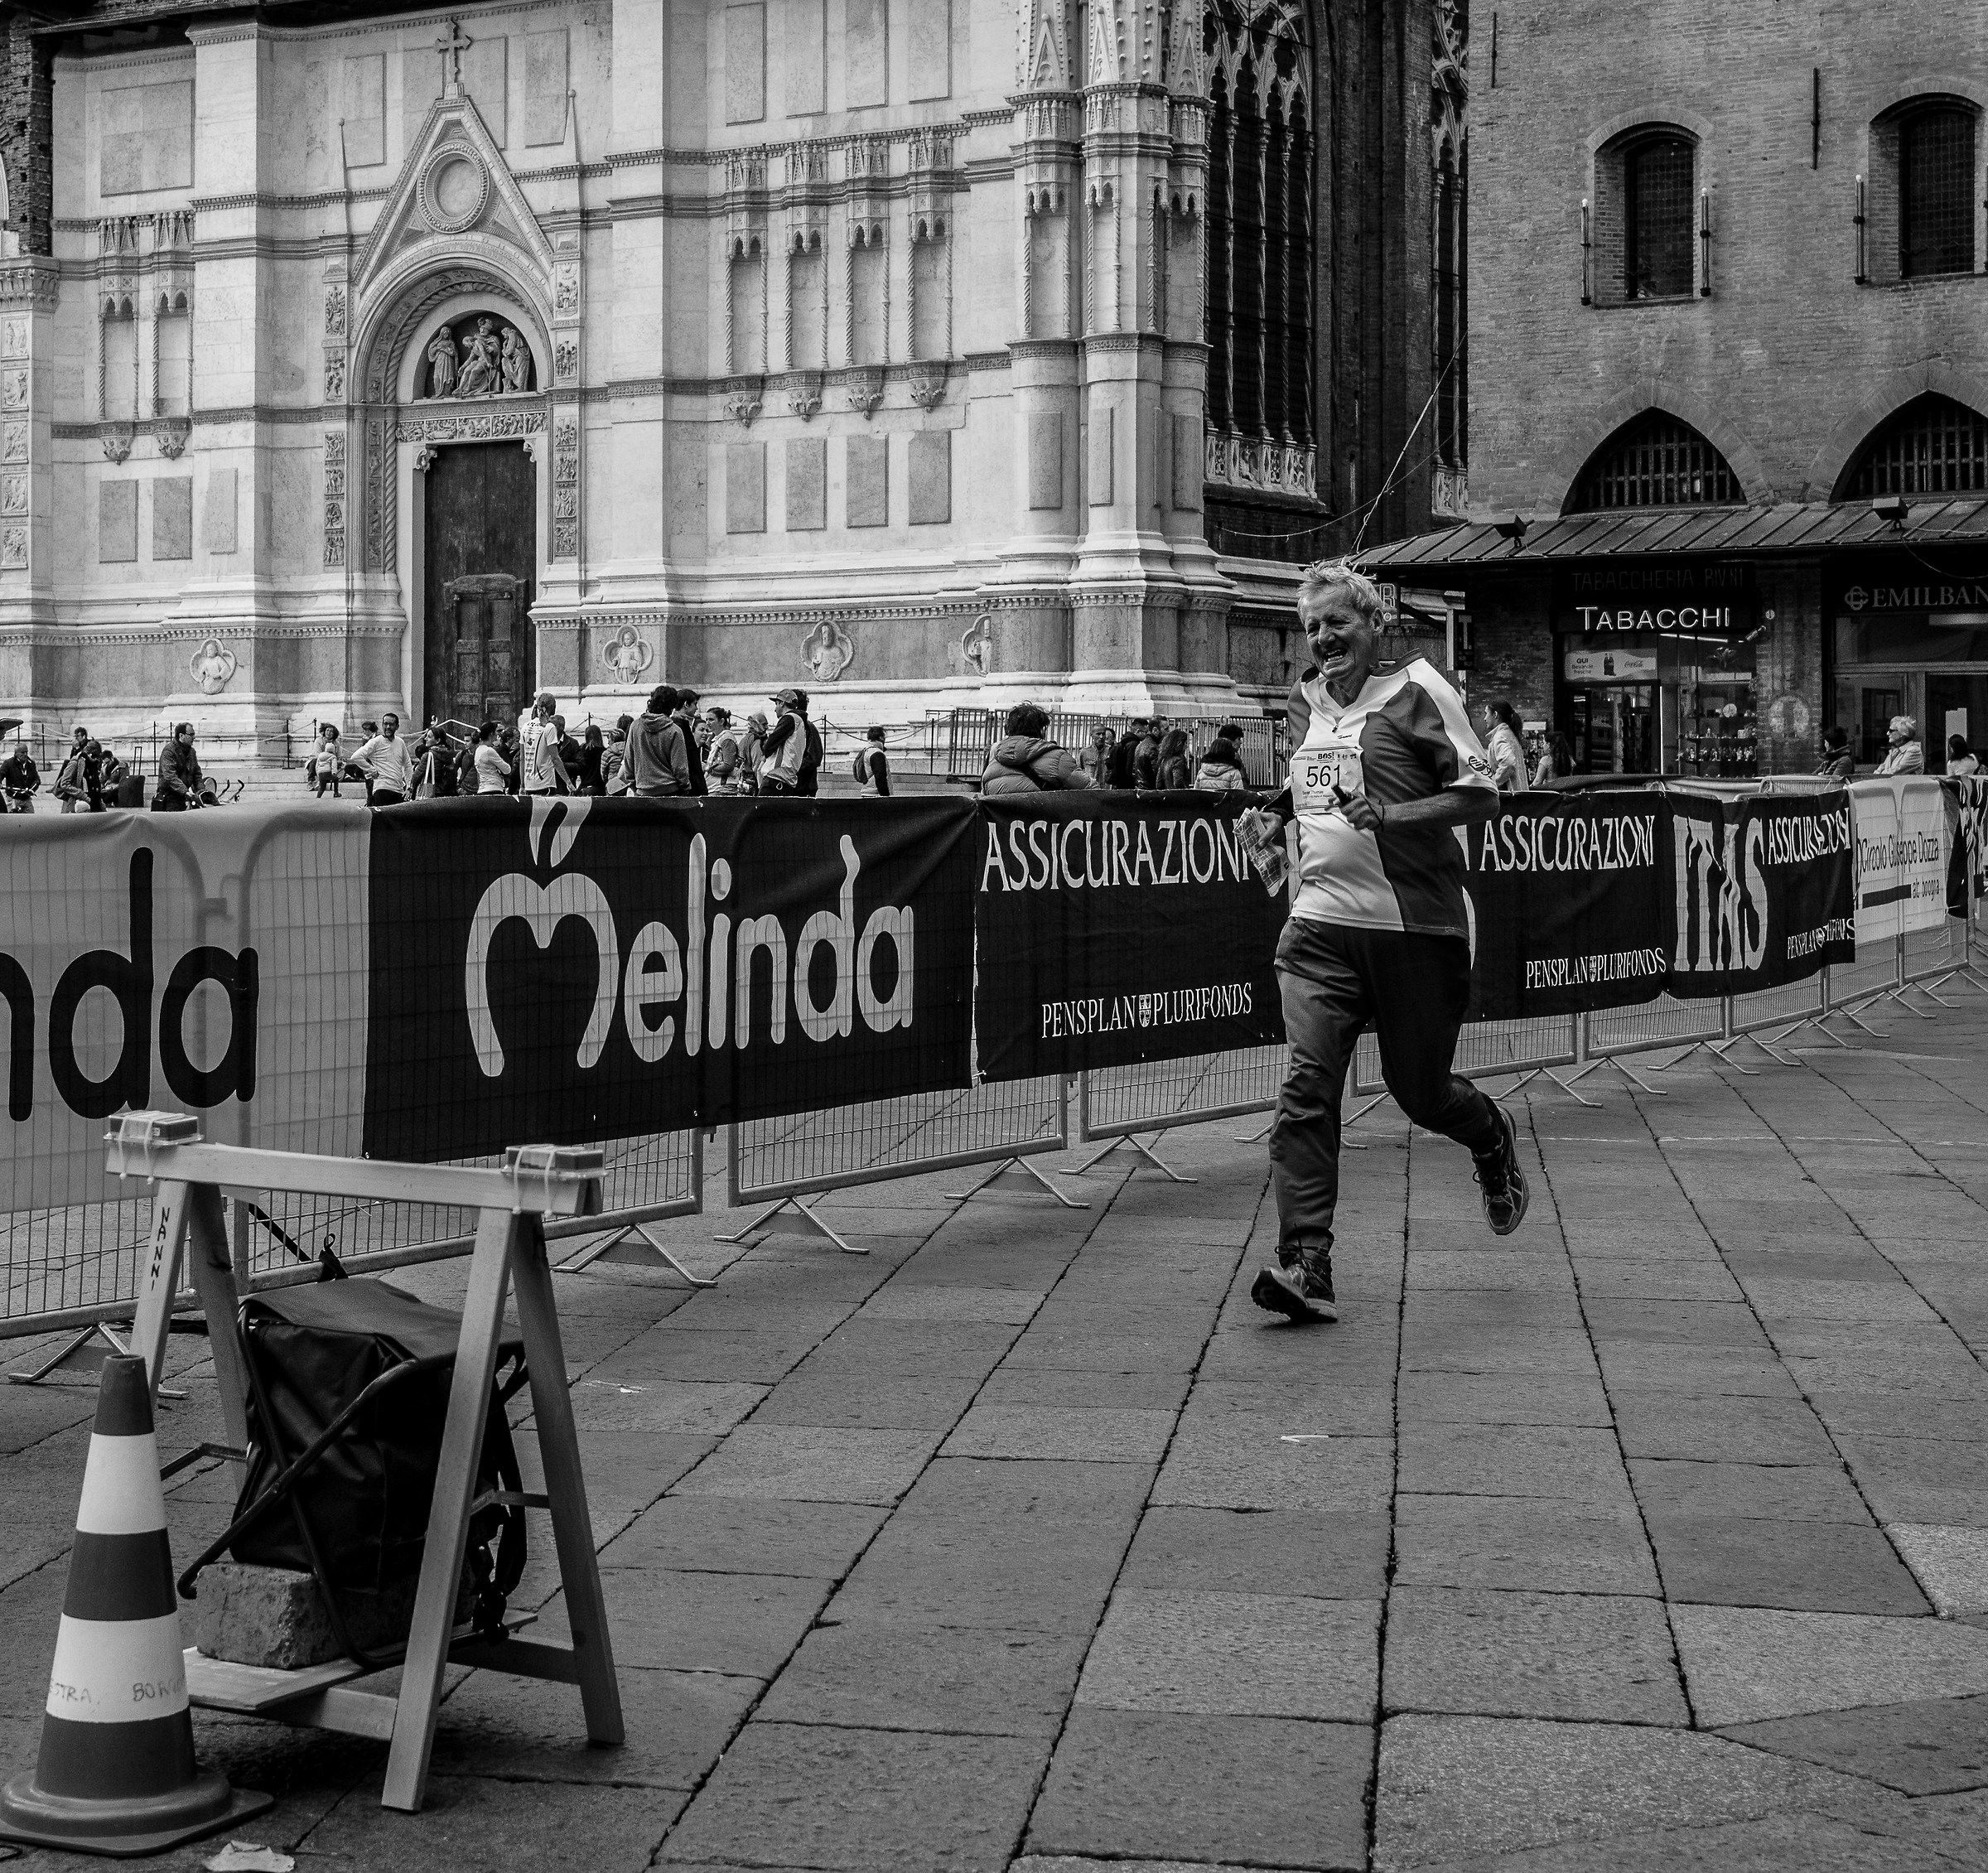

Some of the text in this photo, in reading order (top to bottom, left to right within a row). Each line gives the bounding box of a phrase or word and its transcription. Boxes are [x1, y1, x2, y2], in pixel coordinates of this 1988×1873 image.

[1575, 606, 1730, 631] TABACCHI
[1872, 585, 1988, 607] EMILBAN
[1305, 764, 1340, 788] 561
[980, 818, 1249, 891] ASSICURAZIONI
[1479, 814, 1655, 871] ASSICURAZIONI
[466, 832, 913, 1077] Melinda
[1525, 948, 1667, 989] PENSPLAN PLURIFONDS
[1041, 982, 1252, 1039] PENSPLAN PLURIFONDS
[151, 1206, 170, 1291] NANNI
